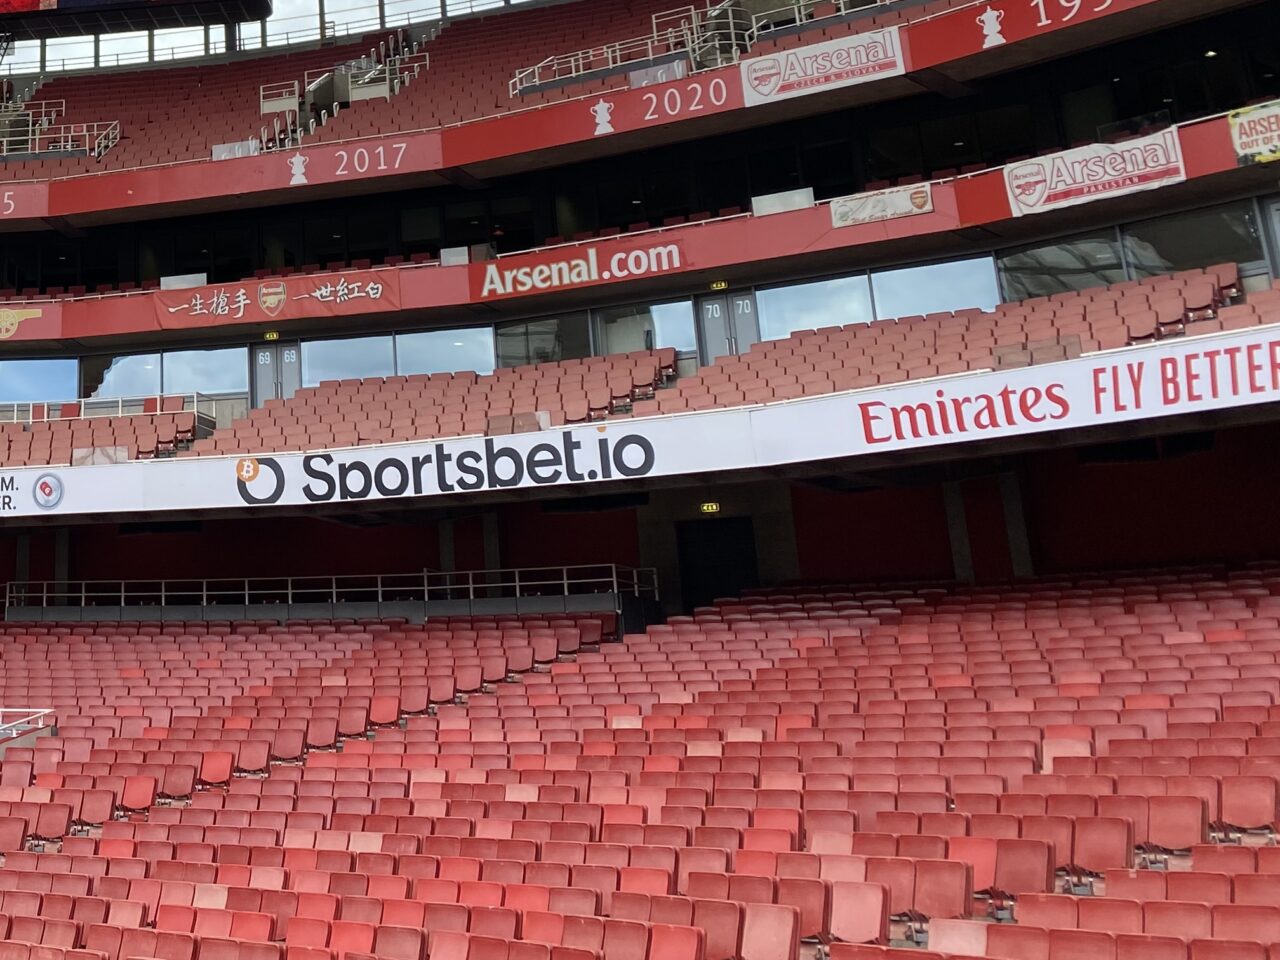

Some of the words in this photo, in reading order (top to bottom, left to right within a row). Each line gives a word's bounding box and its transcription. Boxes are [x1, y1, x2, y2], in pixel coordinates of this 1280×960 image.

[782, 30, 896, 82] Arsenal
[841, 66, 880, 78] SLOVAK
[642, 78, 727, 121] 2020
[335, 143, 407, 175] 2017
[1049, 130, 1179, 191] Arsenal
[1083, 176, 1140, 194] PAKISTAN
[480, 244, 681, 297] Arsenal.com
[705, 304, 720, 318] 70
[736, 300, 751, 314] 70
[258, 352, 270, 364] 69
[284, 350, 296, 362] 69
[857, 382, 1070, 444] Emirates
[1092, 361, 1146, 414] FLY
[1159, 340, 1280, 406] BETTER
[302, 426, 656, 502] Sportsbet.io
